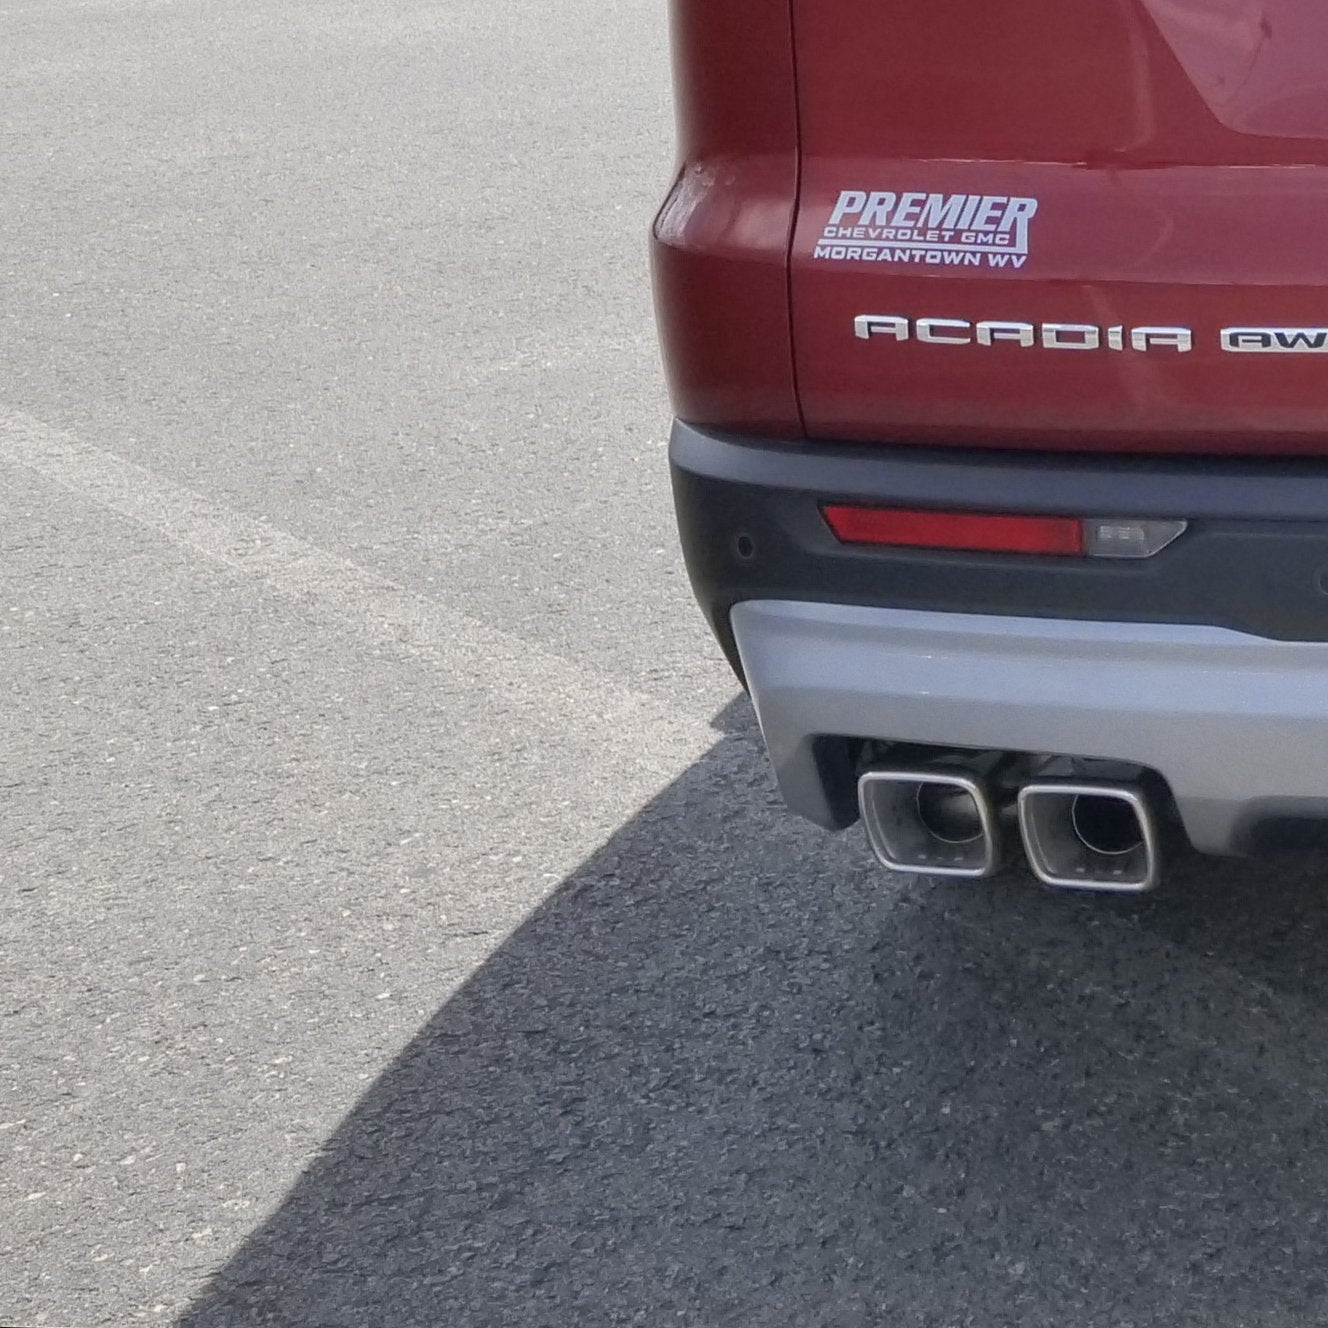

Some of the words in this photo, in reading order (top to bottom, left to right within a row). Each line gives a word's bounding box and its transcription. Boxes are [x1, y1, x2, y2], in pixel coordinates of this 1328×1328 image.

[828, 190, 1039, 248] PREMIER
[823, 226, 955, 242] CHEVROLET
[960, 232, 1010, 245] GMC
[813, 245, 981, 267] MORGANTOWN
[987, 253, 1028, 269] WV
[853, 313, 1193, 353] ACADIA
